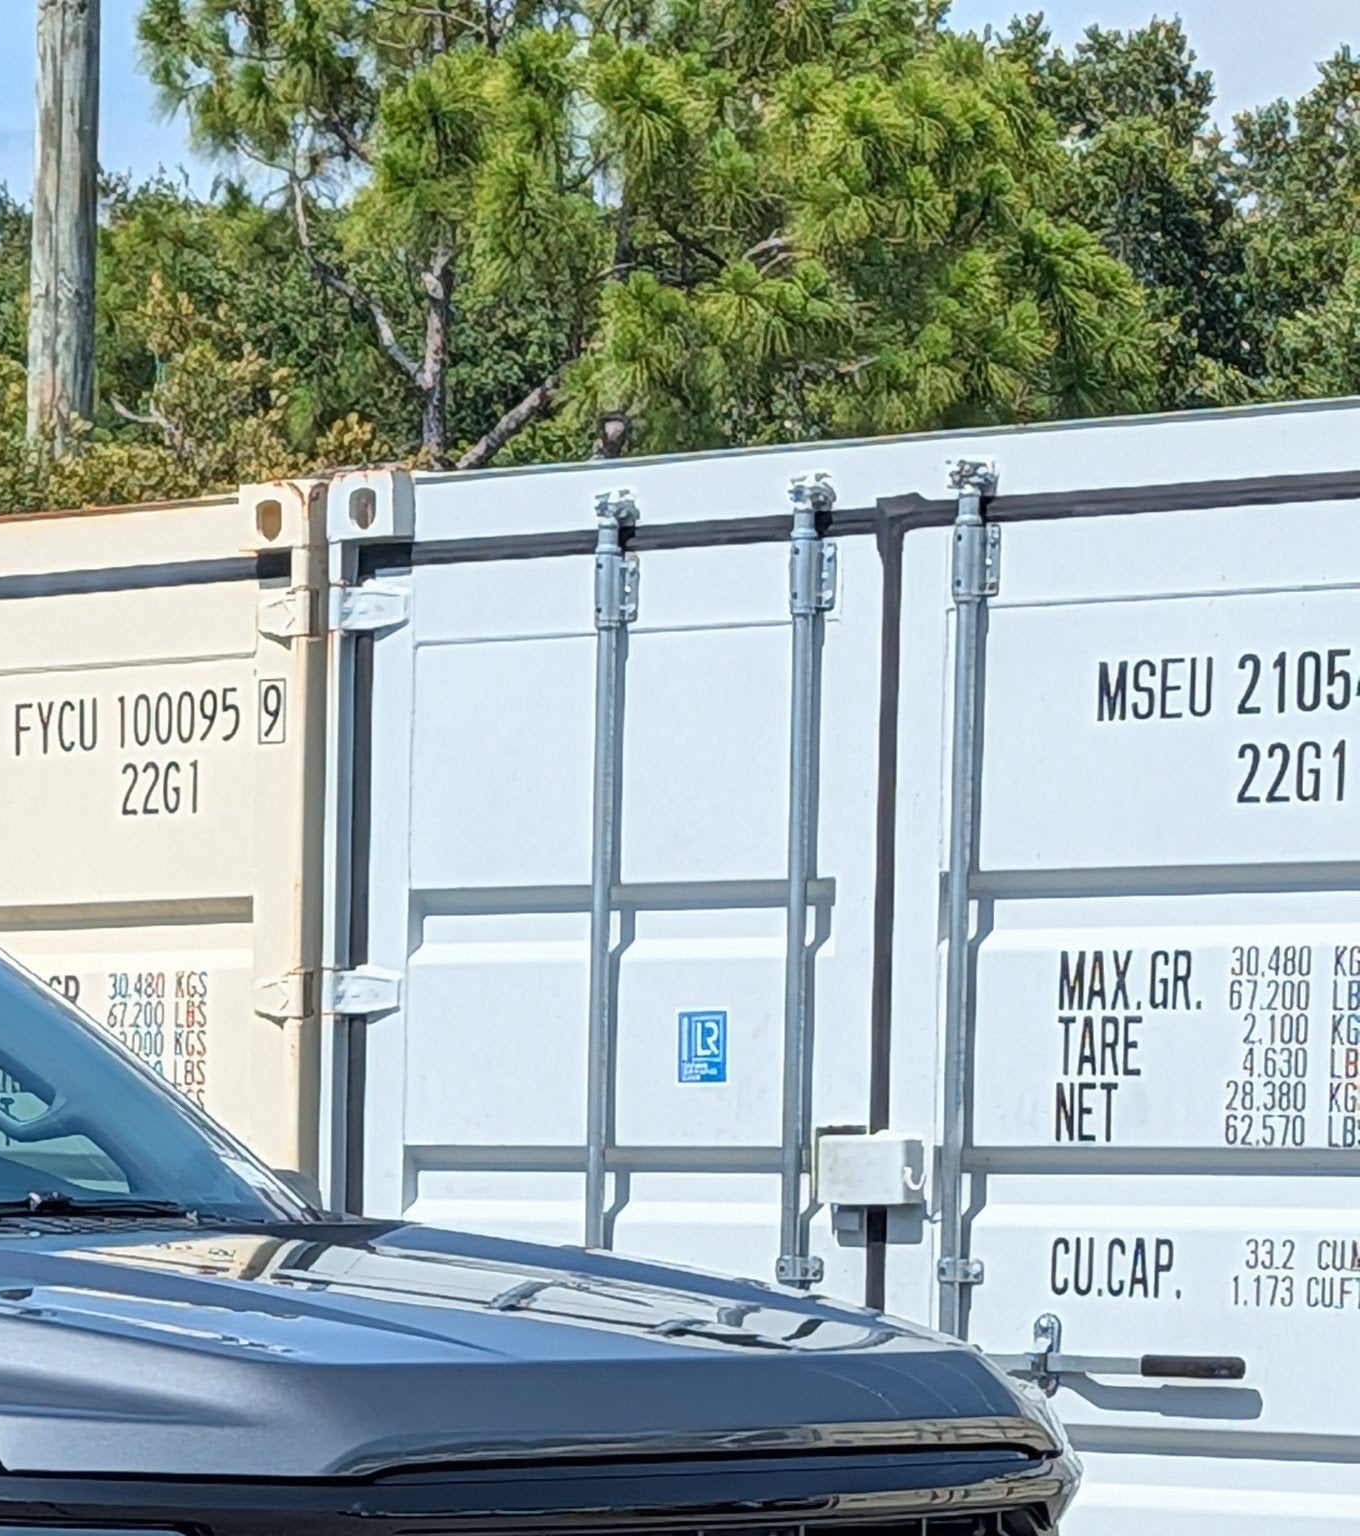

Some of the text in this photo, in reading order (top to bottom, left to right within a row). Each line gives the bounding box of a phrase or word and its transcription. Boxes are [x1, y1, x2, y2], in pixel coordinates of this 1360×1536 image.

[1096, 647, 1360, 722] MSEU 2105
[14, 682, 283, 757] FYCU 100095 9
[121, 759, 199, 816] 22G1
[1236, 738, 1347, 804] 22G1
[1230, 945, 1312, 978] 30.480
[175, 970, 209, 1000] KGS
[1057, 949, 1203, 1011] MAX.GR.
[1228, 979, 1311, 1012] 67.200
[174, 1000, 208, 1029] LBS
[1242, 1012, 1309, 1046] 2.100
[173, 1029, 207, 1058] KGS
[1057, 1015, 1143, 1077] TARE
[173, 1058, 207, 1087] LBS
[1241, 1047, 1308, 1080] 4.630
[1054, 1082, 1119, 1142] NET
[1224, 1080, 1360, 1113] 28.380 KG
[1224, 1113, 1360, 1148] 62.570 LB
[1049, 1236, 1182, 1300] CU.CAP.
[1244, 1238, 1296, 1270] 33.2
[1232, 1274, 1294, 1307] 1.173
